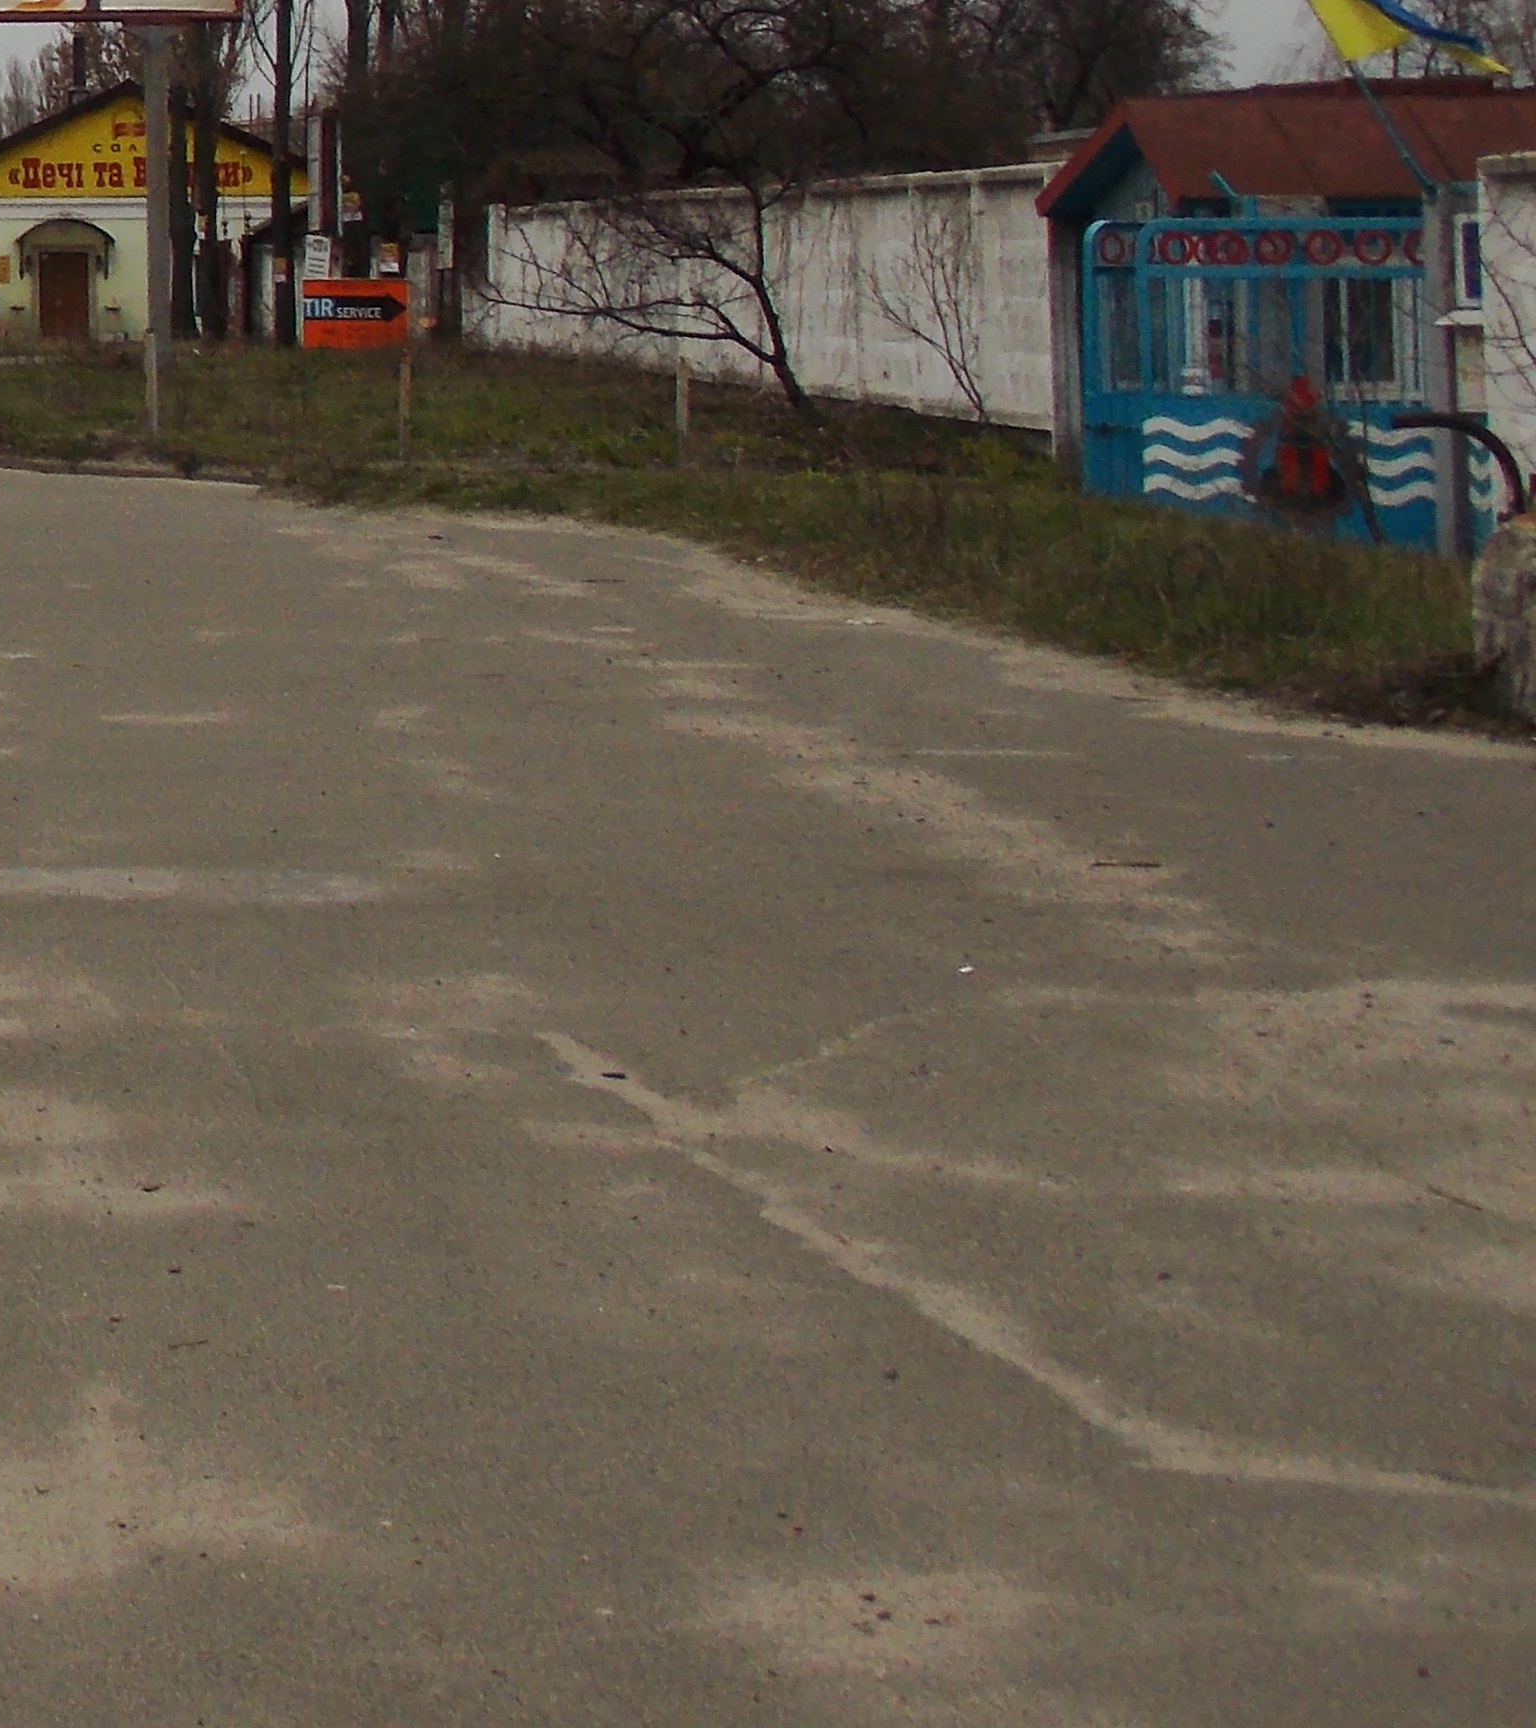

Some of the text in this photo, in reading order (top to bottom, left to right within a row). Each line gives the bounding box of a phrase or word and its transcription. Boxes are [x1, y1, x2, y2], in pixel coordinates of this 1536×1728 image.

[93, 162, 125, 187] та
[303, 298, 382, 319] TIR SERVICE
